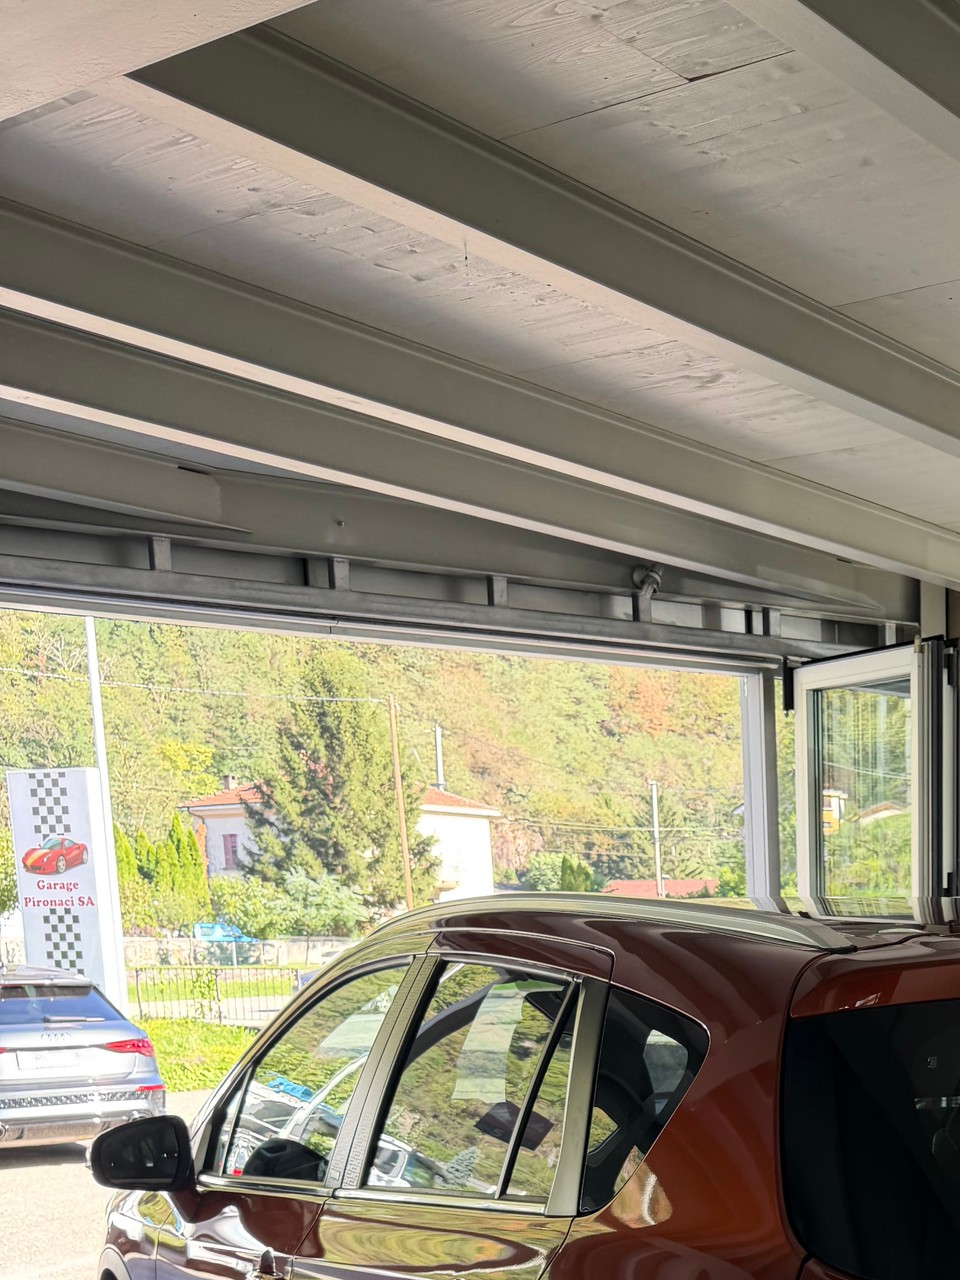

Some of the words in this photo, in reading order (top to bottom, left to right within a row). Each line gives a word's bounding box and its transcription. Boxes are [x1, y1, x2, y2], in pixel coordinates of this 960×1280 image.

[36, 879, 79, 893] Garage
[23, 896, 75, 908] Pironaci
[77, 896, 96, 907] SA
